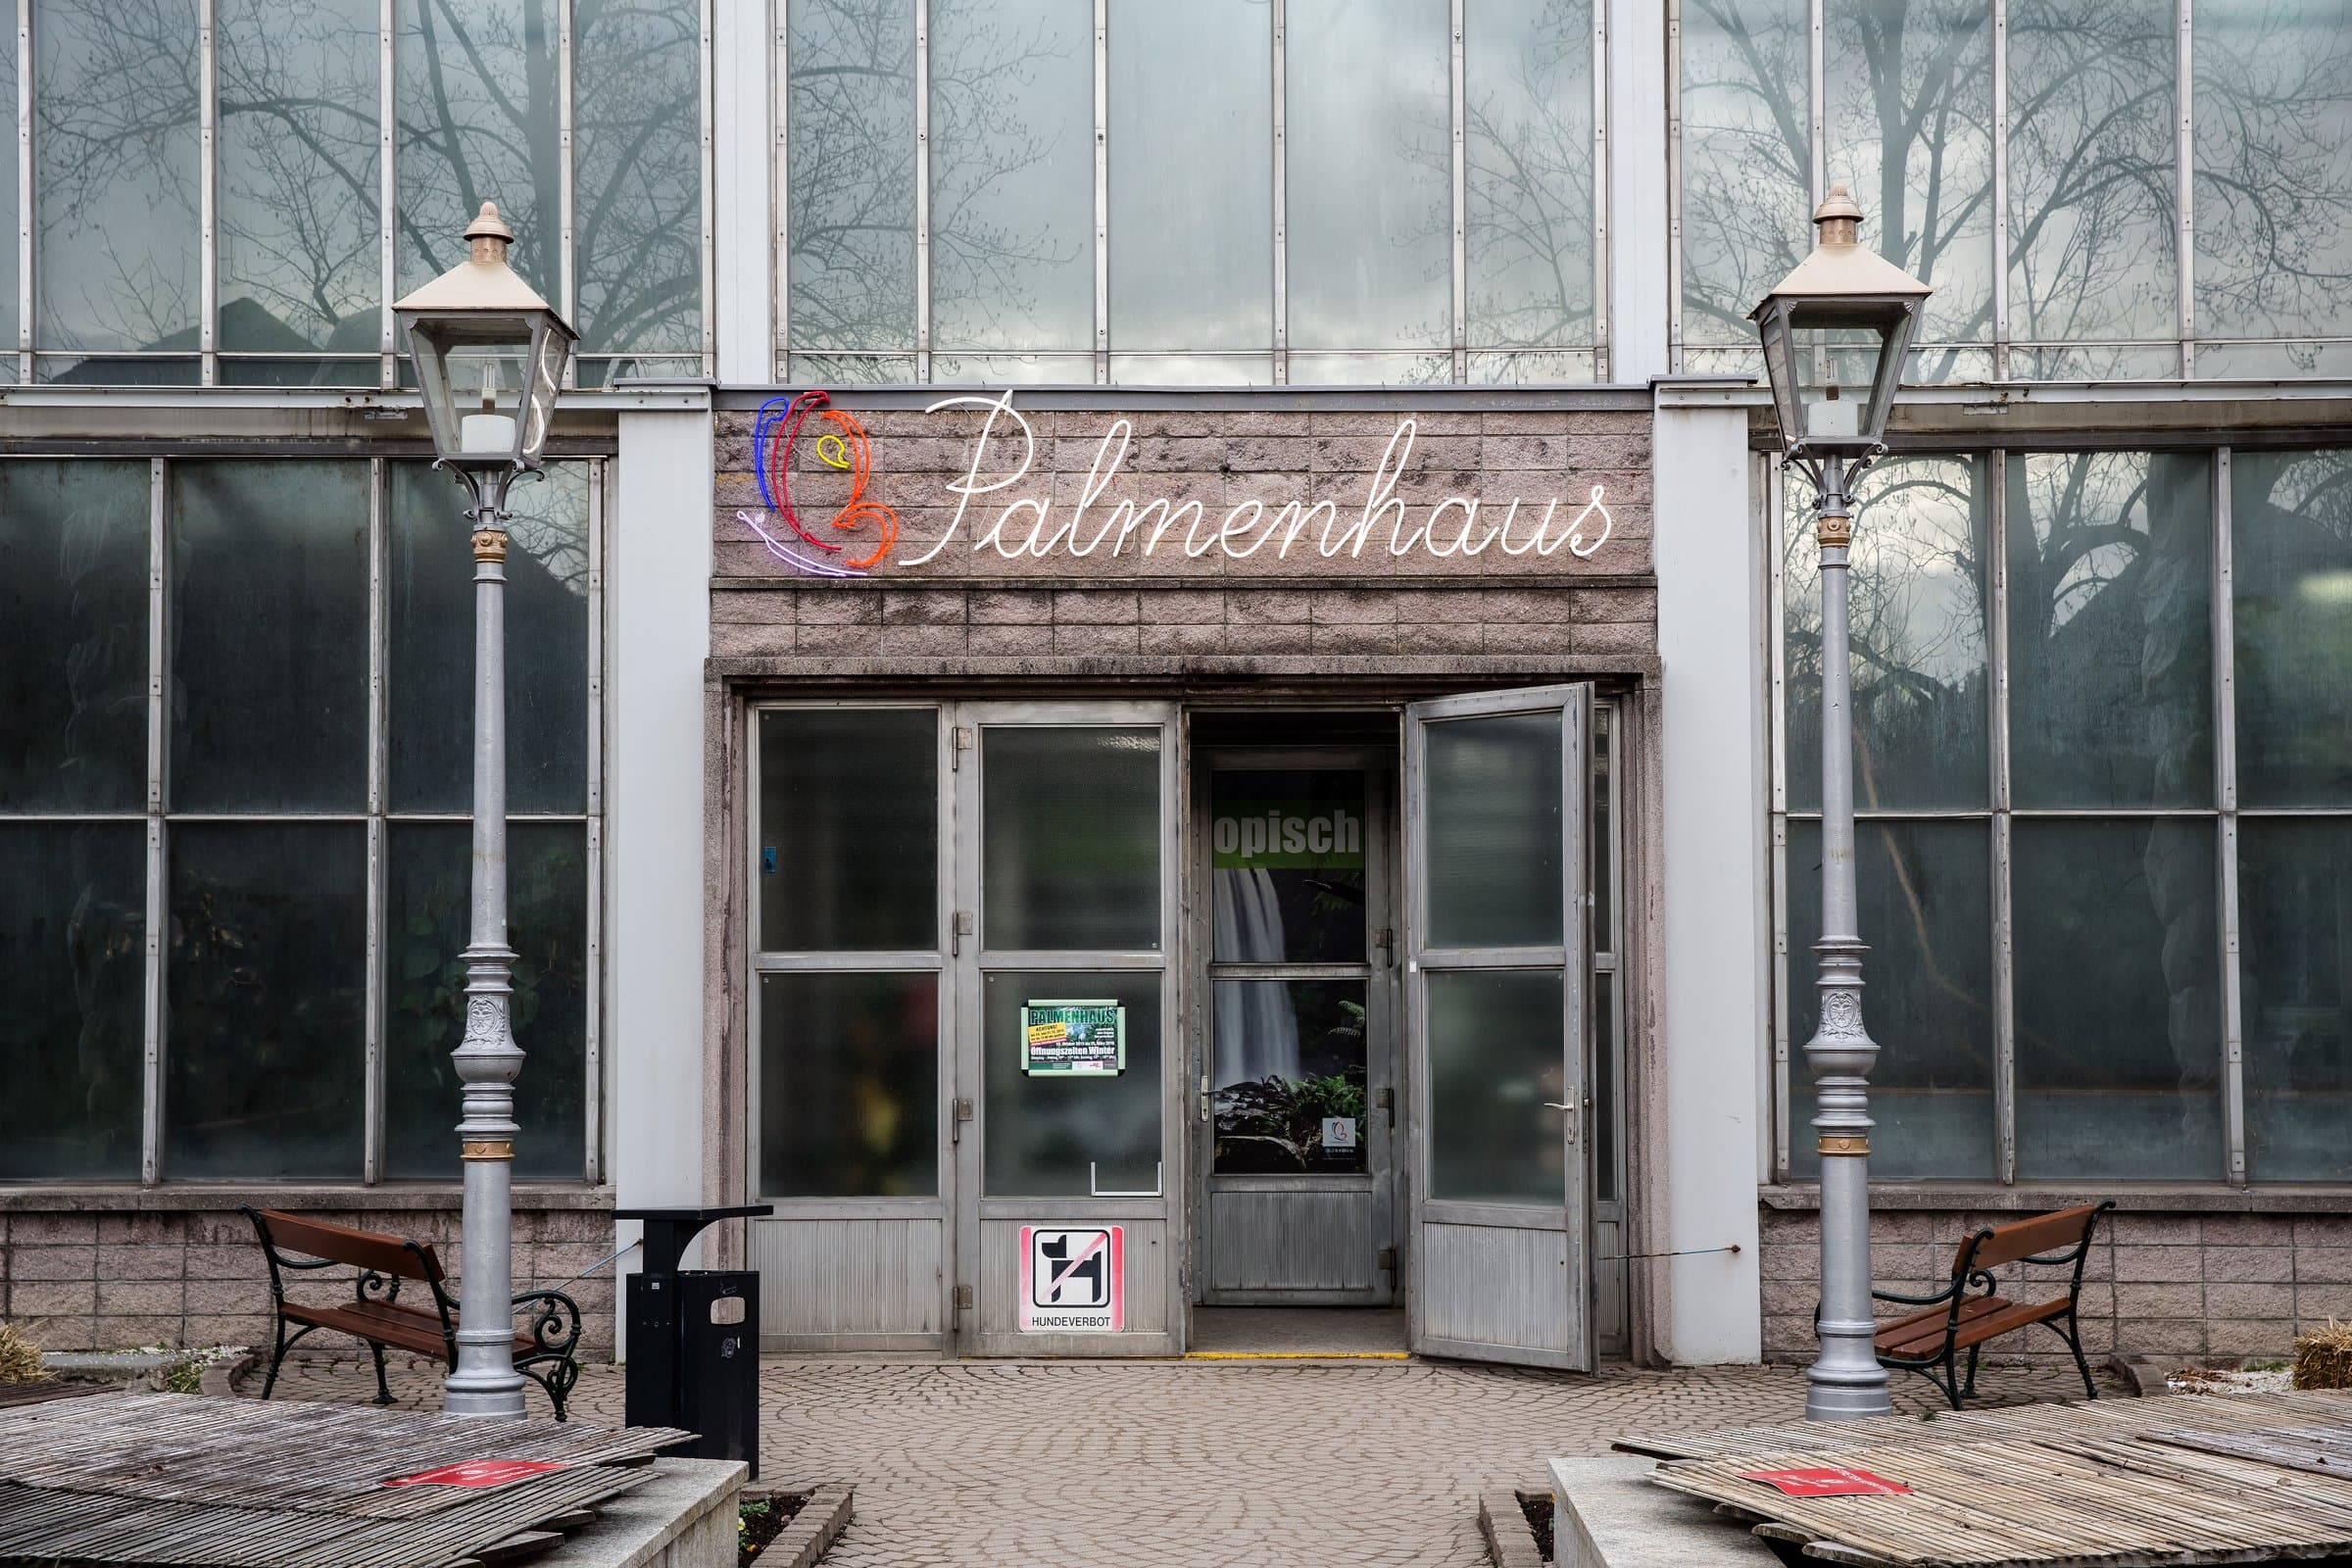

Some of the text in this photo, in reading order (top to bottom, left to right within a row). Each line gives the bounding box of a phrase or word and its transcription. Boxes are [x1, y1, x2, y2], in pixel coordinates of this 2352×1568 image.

[898, 387, 1614, 567] Palmenhaus
[1213, 809, 1360, 858] opisch
[1030, 1009, 1114, 1025] PALMENHAUS
[1089, 1046, 1115, 1055] Winter
[1032, 1316, 1111, 1327] HUNDEVERBOT
